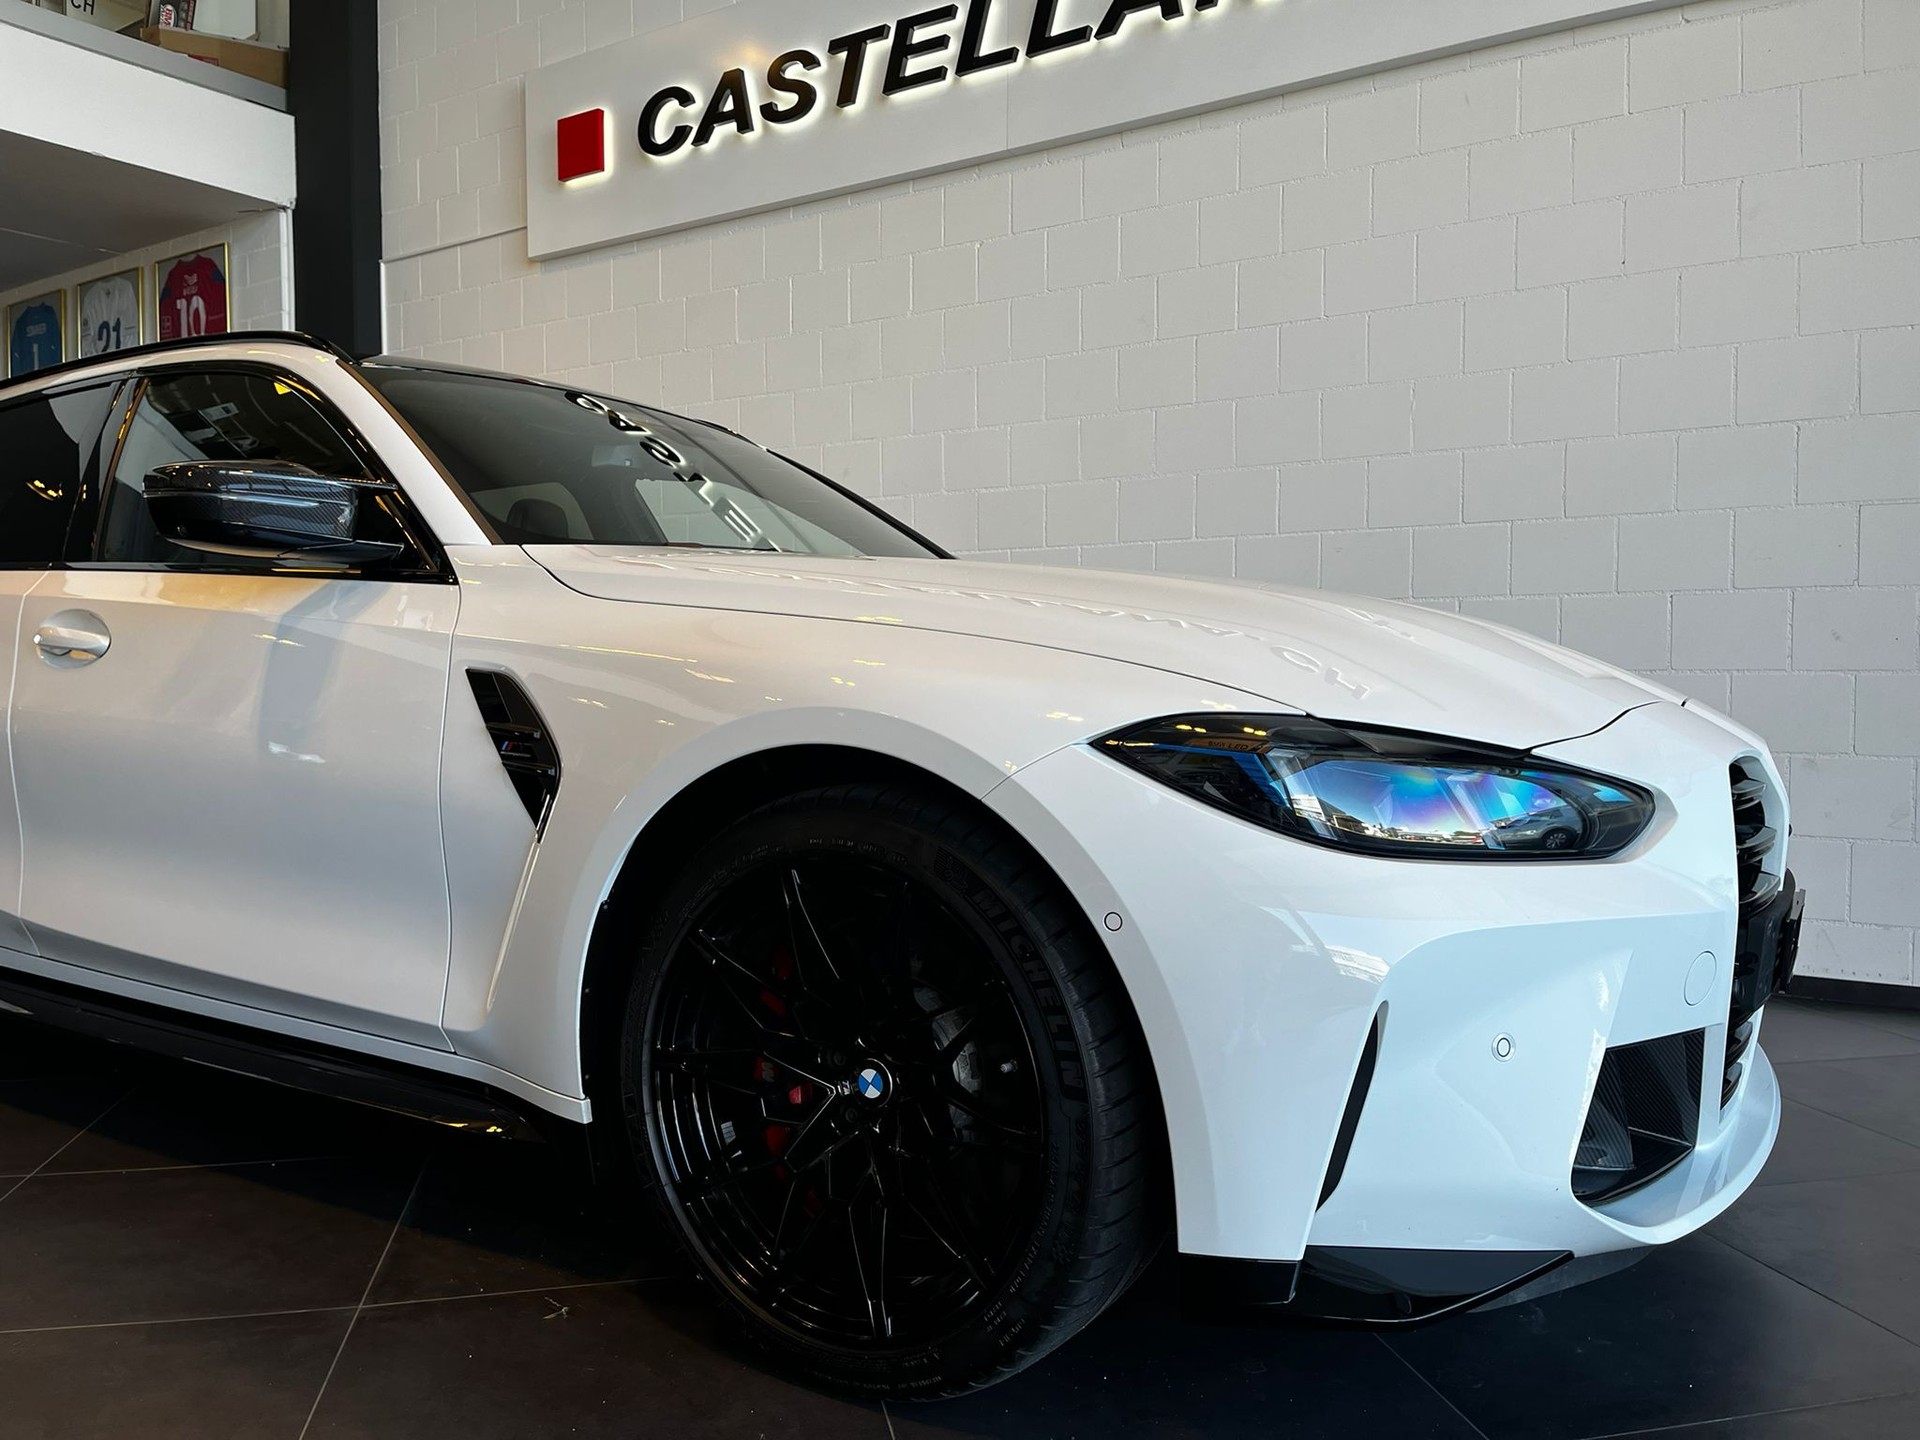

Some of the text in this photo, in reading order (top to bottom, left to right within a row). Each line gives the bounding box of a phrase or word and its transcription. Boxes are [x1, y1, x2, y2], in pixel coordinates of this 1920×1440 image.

[636, 0, 1219, 157] CASTELL
[97, 317, 121, 352] 21
[176, 295, 207, 338] 10
[971, 889, 1085, 1090] MICHELIN
